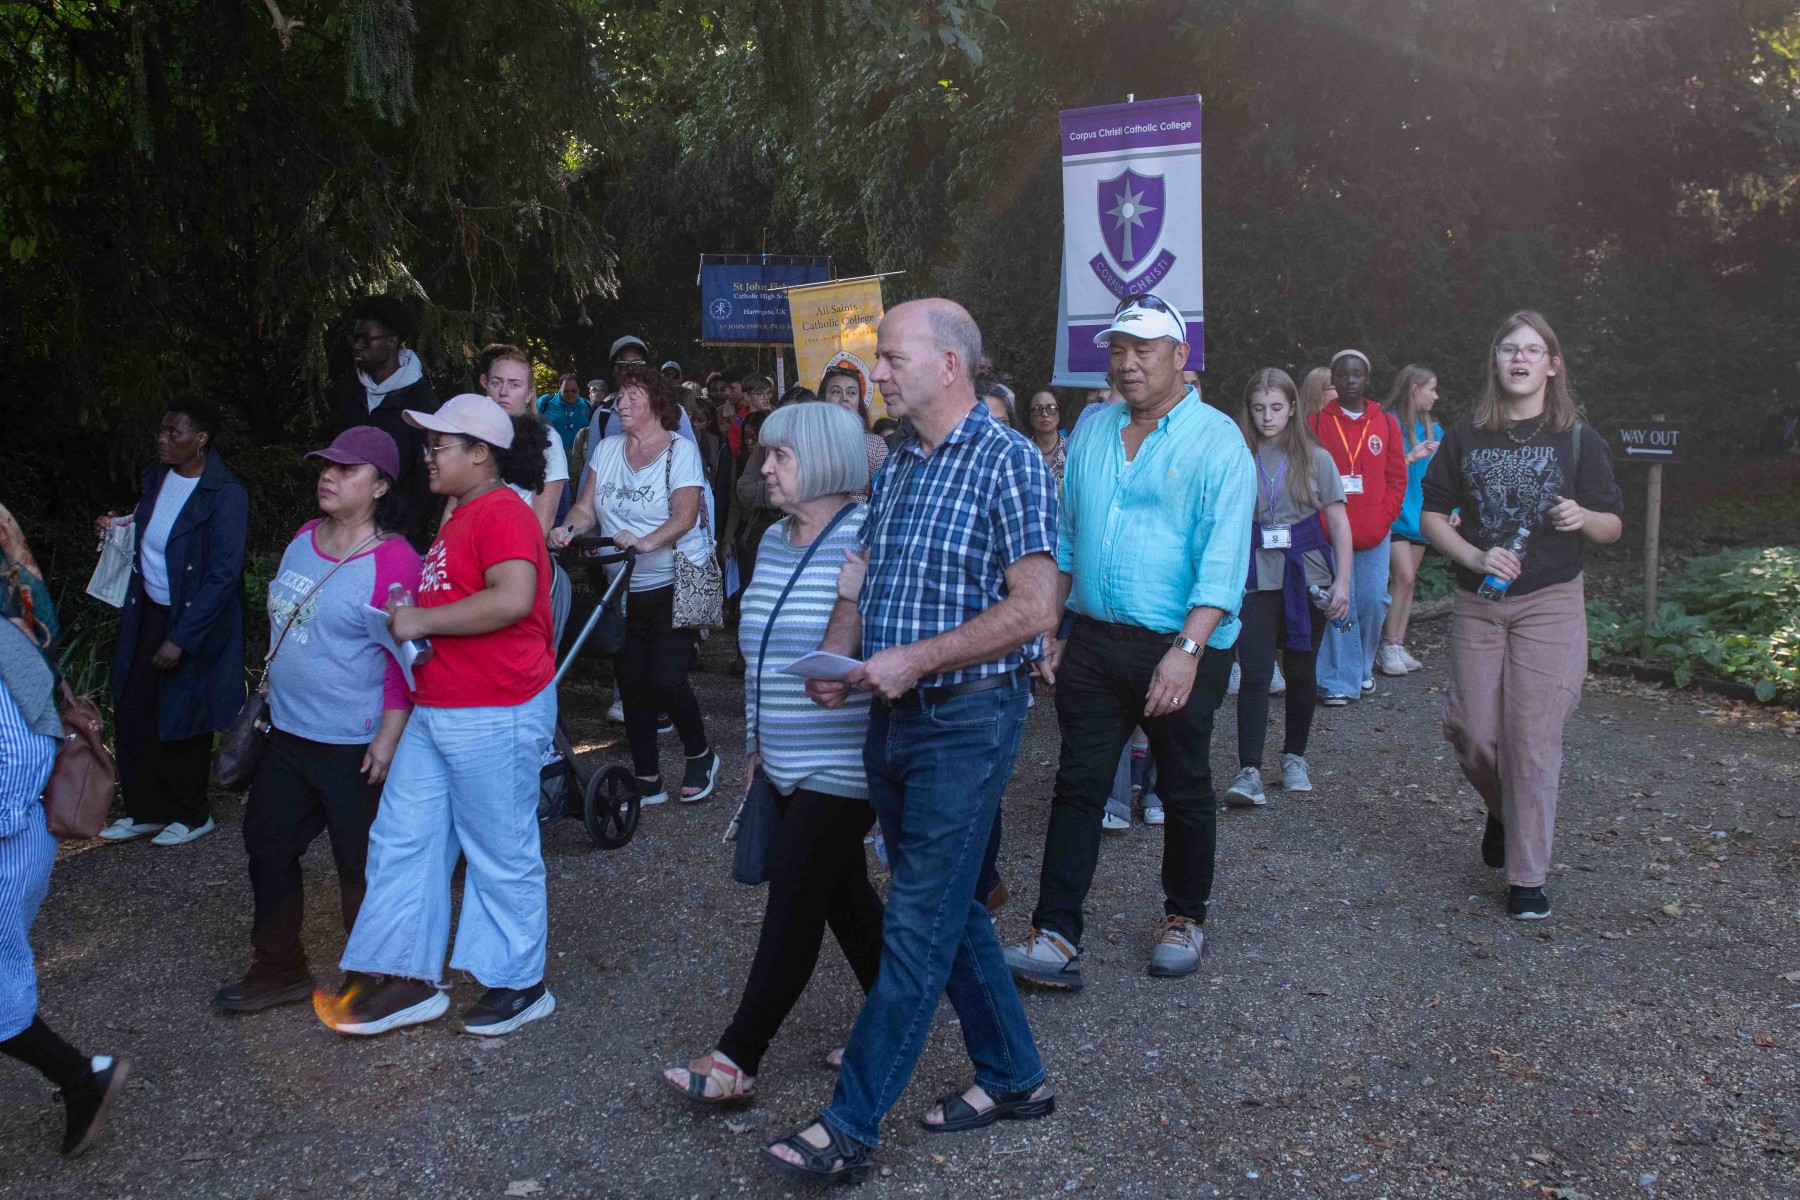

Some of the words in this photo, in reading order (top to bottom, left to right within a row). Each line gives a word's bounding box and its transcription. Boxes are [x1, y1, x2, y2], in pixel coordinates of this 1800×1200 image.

[1069, 130, 1097, 141] Corpus
[1099, 126, 1123, 138] Christi
[1124, 124, 1158, 135] Catholic
[1160, 120, 1192, 131] College
[1096, 262, 1125, 295] CORPUS
[1129, 259, 1168, 295] CHRISTI
[733, 282, 743, 291] St
[745, 282, 767, 292] John
[816, 305, 829, 316] All
[831, 303, 858, 314] Saints
[802, 318, 840, 331] Catholic
[841, 314, 875, 325] College
[1620, 428, 1647, 444] WAY
[1650, 430, 1680, 446] OUT
[1470, 448, 1511, 461] LOST
